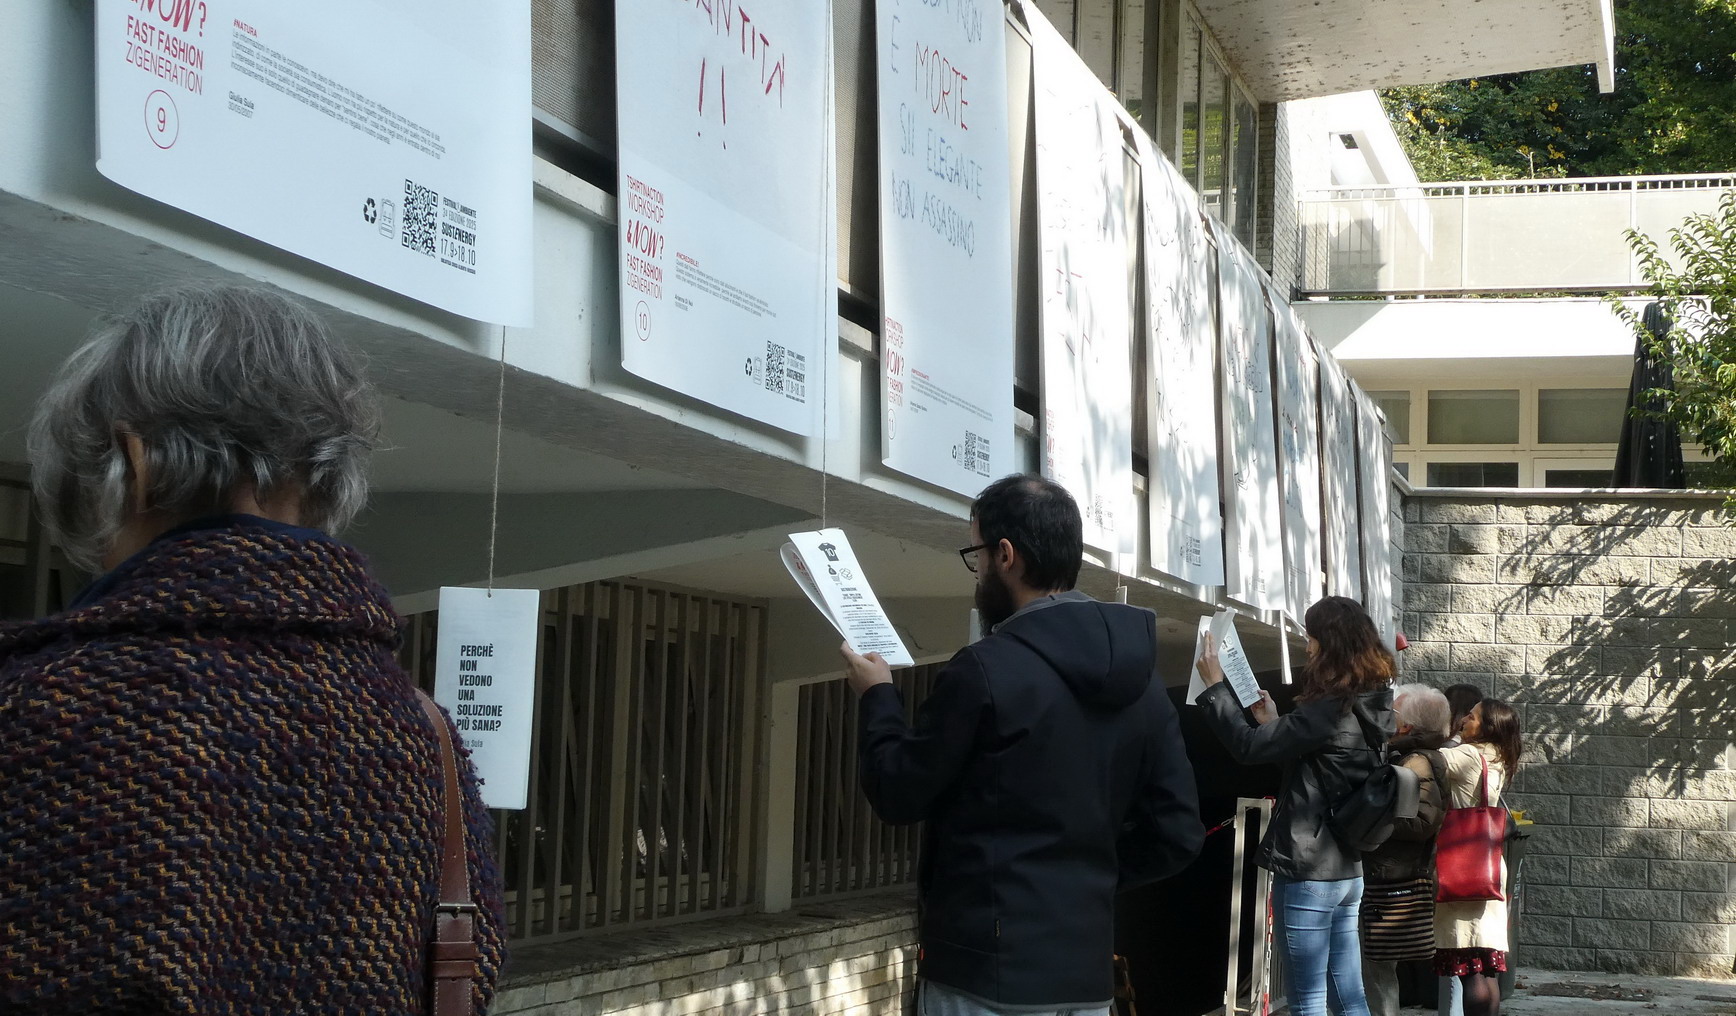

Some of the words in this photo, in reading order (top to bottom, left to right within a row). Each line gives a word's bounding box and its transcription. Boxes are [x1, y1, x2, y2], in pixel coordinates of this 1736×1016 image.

[233, 18, 257, 37] #NATURA
[127, 15, 155, 46] FAST
[158, 30, 203, 70] FASHION
[126, 41, 202, 95] Z/GENERATION
[915, 41, 968, 131] MORTE
[157, 107, 166, 132] 9
[927, 127, 983, 200] ELEGANTE
[627, 190, 664, 224] WORKSHOP
[627, 253, 640, 271] FAST
[640, 260, 662, 283] FASHION
[639, 314, 647, 330] 10
[460, 643, 493, 657] PERCHÈ
[460, 660, 477, 672] NON
[459, 674, 493, 687] VEDONO
[458, 689, 475, 701] UNA
[457, 704, 503, 717] SOLUZIONE
[456, 717, 469, 730] PIÙ
[472, 719, 501, 732] SANA?
